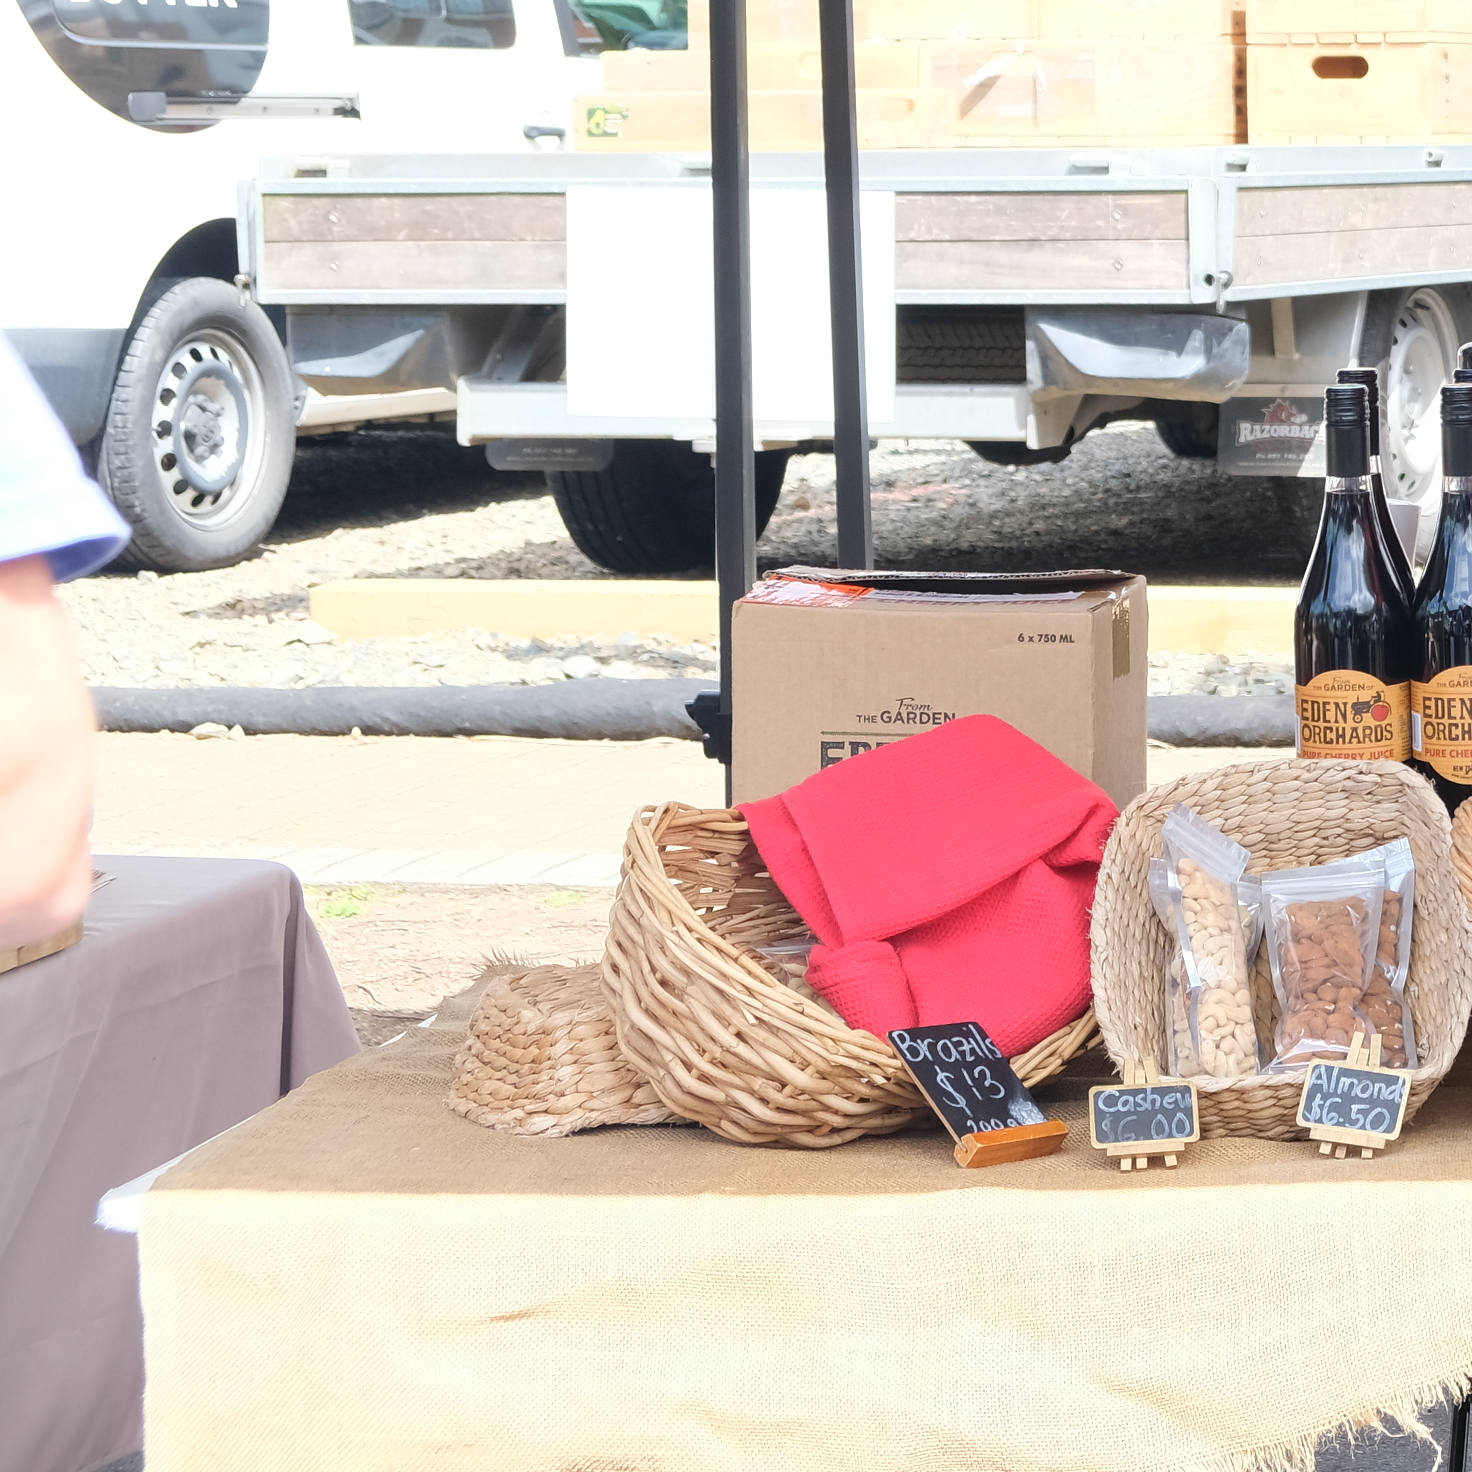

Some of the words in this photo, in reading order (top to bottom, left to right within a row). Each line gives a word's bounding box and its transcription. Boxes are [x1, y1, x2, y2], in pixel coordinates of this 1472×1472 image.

[1017, 633, 1025, 643] 6
[1027, 635, 1035, 643] x
[1036, 633, 1057, 643] 750
[1058, 634, 1075, 643] ML
[1324, 684, 1366, 692] GARDEN
[895, 696, 934, 712] From
[1301, 698, 1348, 724] EDEN
[856, 714, 878, 724] THE
[880, 710, 956, 725] GARDEN
[1302, 723, 1394, 745] ORCHARDS
[1425, 748, 1447, 758] PURE
[892, 1023, 1003, 1063] Brazils
[934, 1065, 1006, 1118] $13
[1304, 1093, 1391, 1133] $6.50
[1101, 1112, 1191, 1143] $6.00
